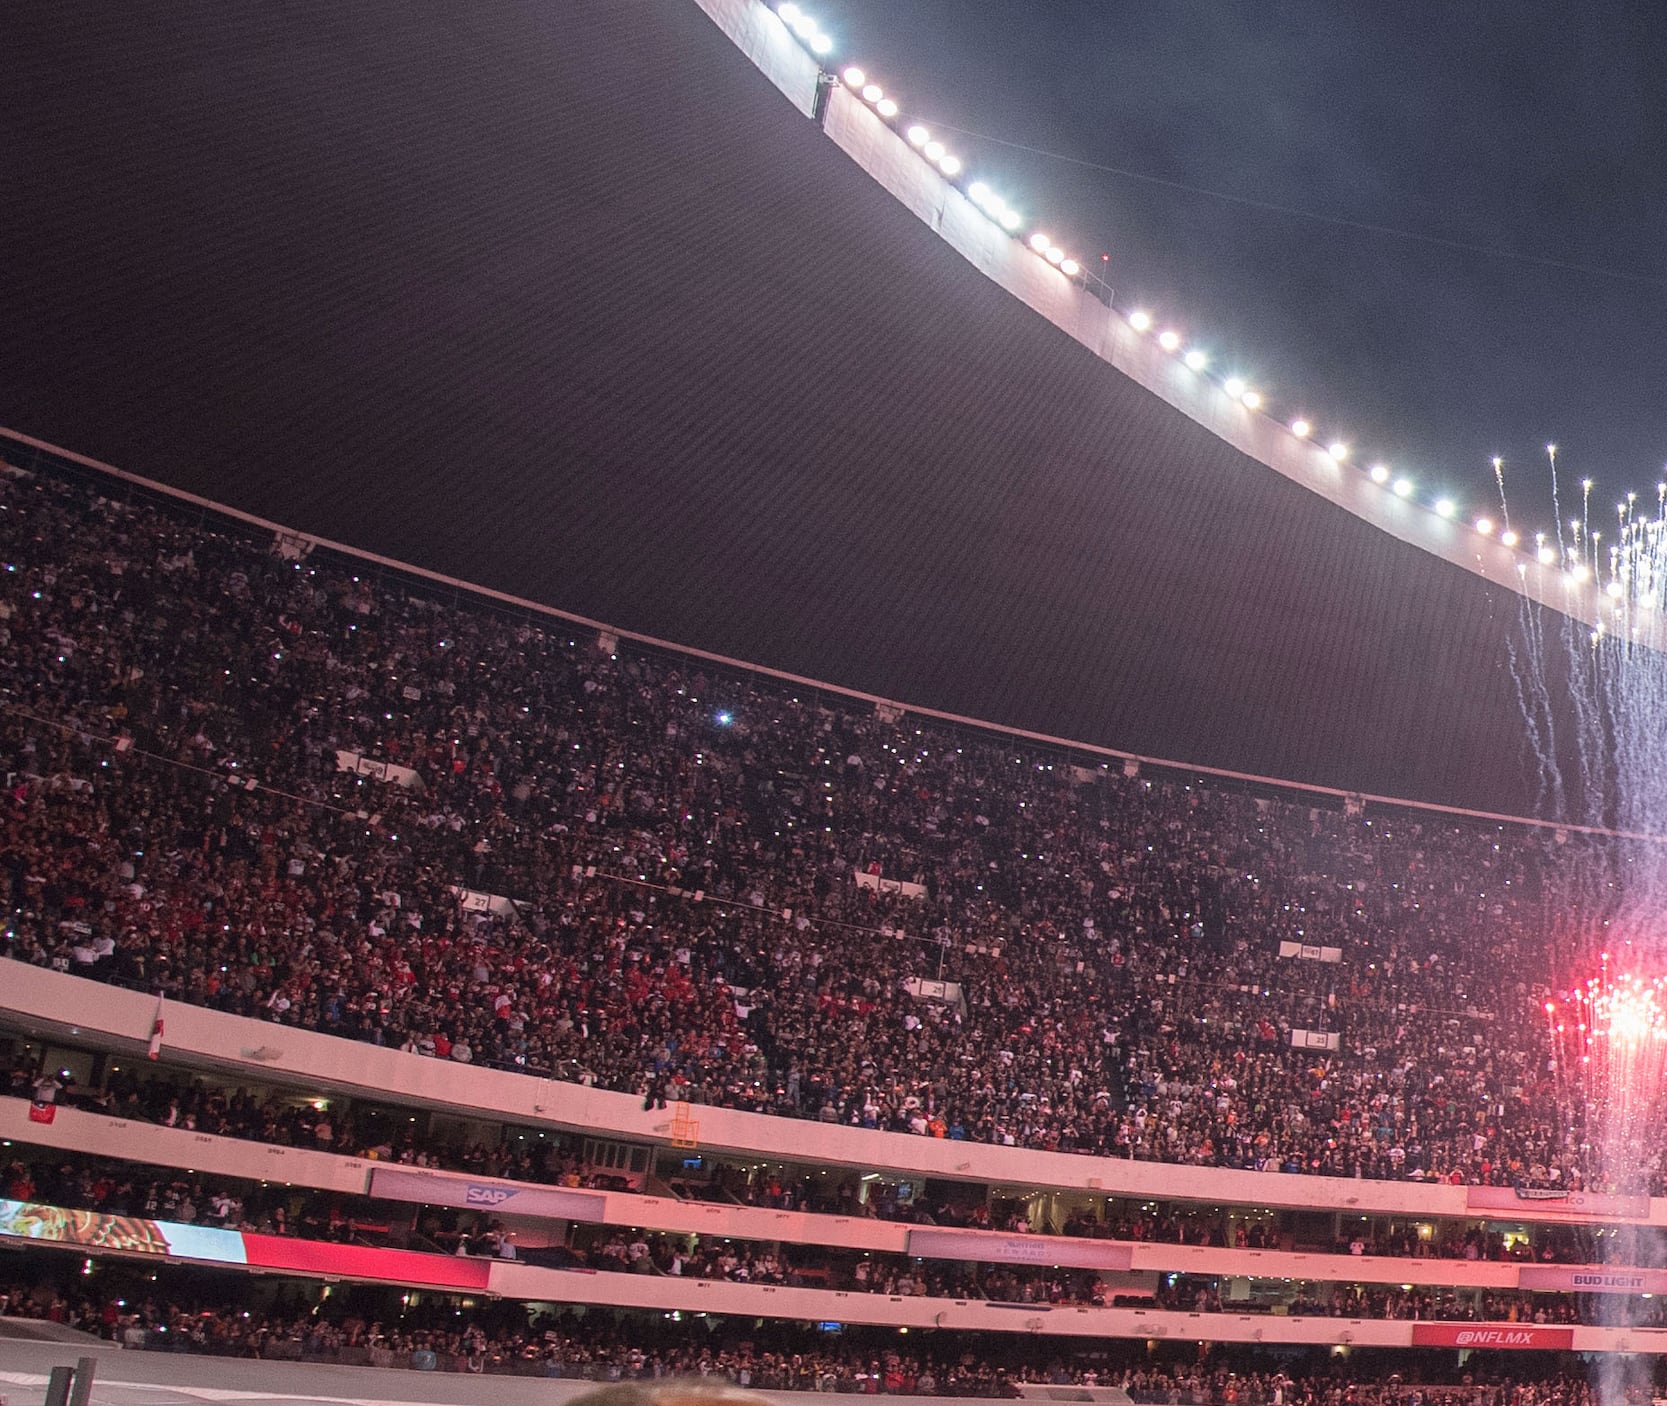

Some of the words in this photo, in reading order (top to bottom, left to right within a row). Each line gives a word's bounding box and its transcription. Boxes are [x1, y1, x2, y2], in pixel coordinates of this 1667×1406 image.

[474, 898, 487, 907] 27
[467, 1187, 509, 1204] SAP
[1573, 1275, 1602, 1286] BUD
[1604, 1275, 1644, 1288] LIGHT
[1456, 1331, 1533, 1345] @NFLMX
